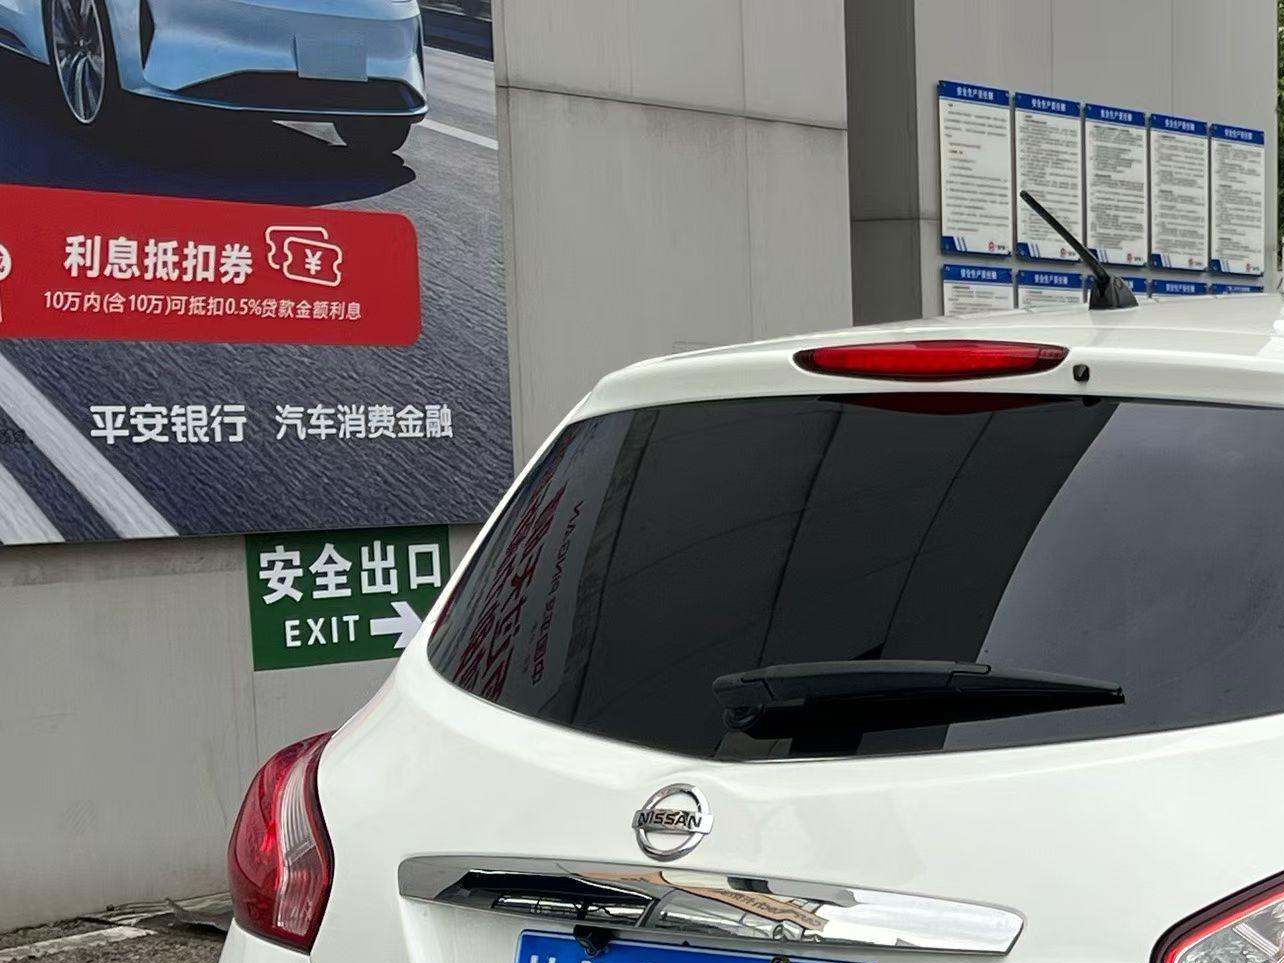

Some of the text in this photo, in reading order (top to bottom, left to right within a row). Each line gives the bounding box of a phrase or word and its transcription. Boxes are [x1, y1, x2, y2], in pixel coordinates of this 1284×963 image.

[64, 235, 253, 284] 利息抵扣券
[44, 291, 361, 320] 10万内(含10万)可抵扣0.5%贷款金额利息
[90, 403, 453, 444] 平安银行 汽车消费金融
[259, 540, 441, 604] 安全出口
[285, 615, 359, 647] EXIT
[638, 811, 702, 829] NISSAN
